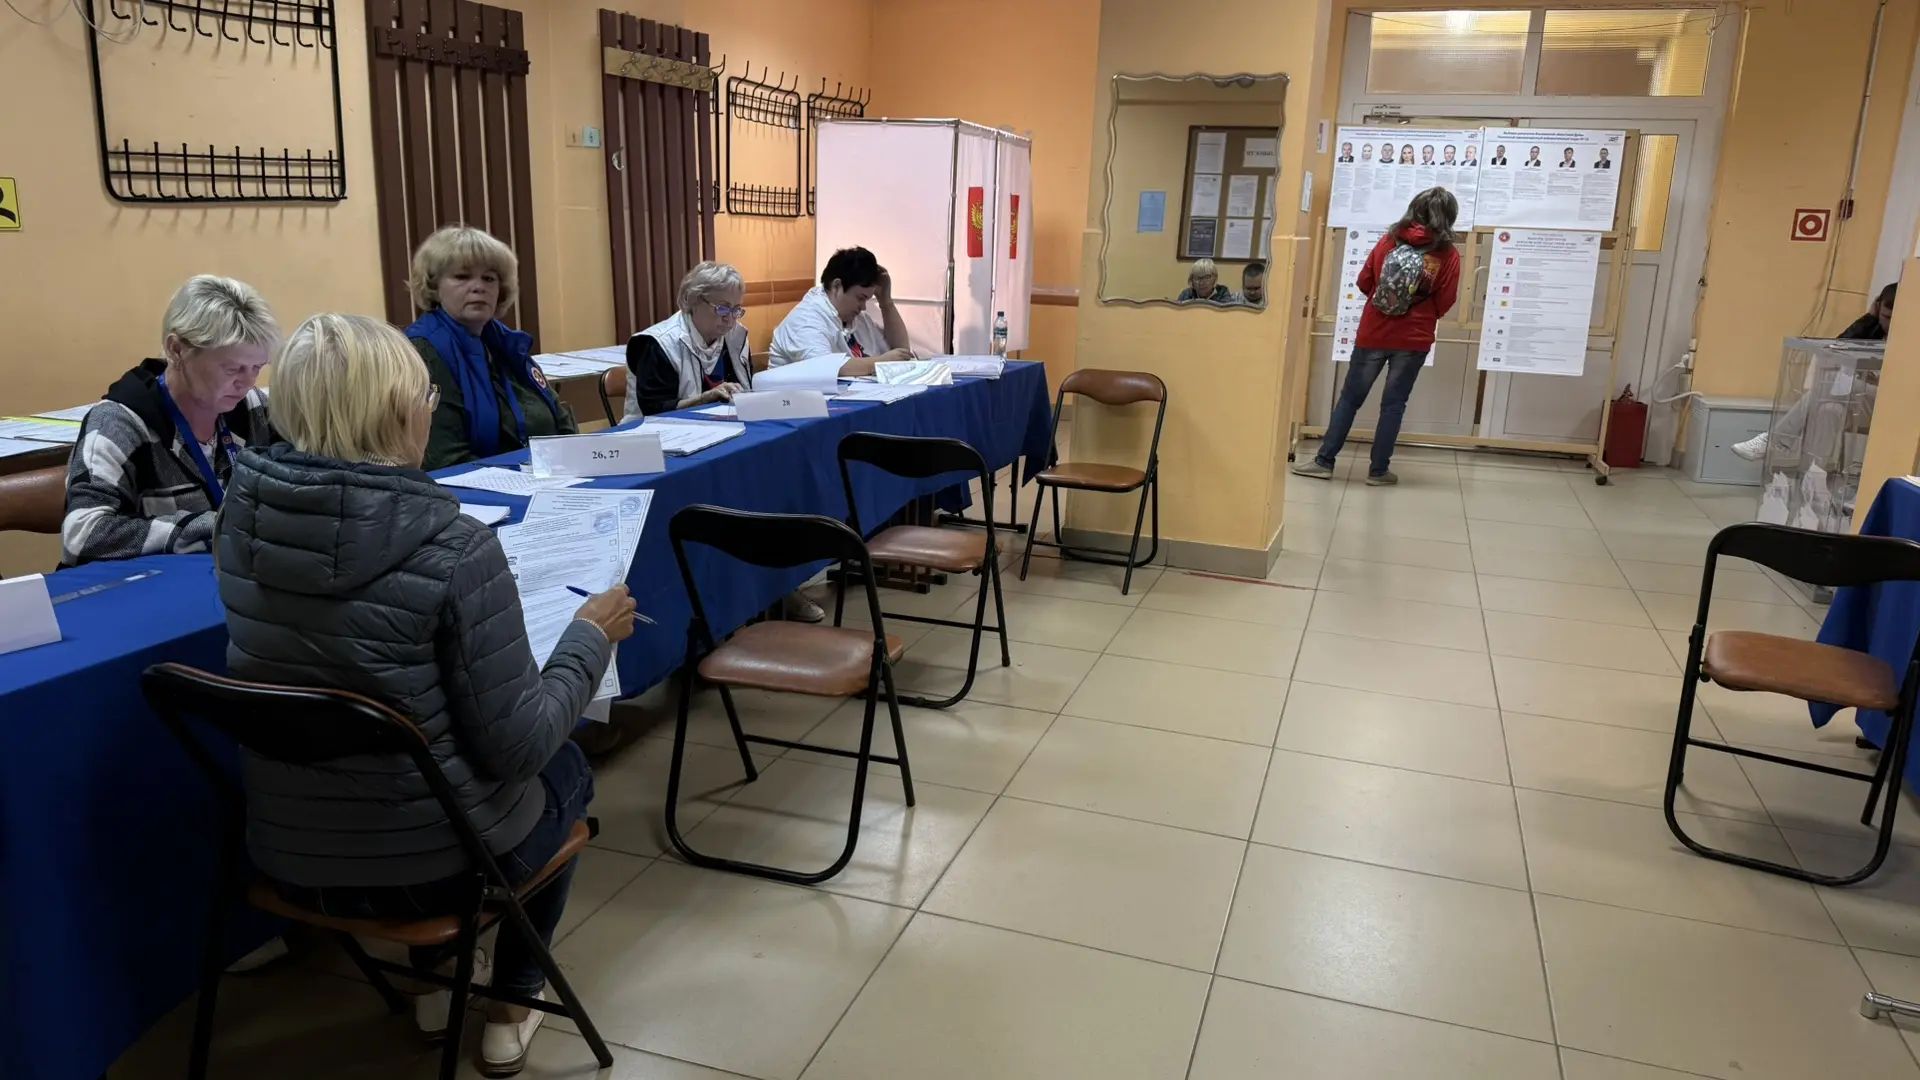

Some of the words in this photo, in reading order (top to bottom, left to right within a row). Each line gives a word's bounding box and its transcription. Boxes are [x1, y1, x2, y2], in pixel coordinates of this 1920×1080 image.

[782, 399, 791, 407] 28
[592, 450, 607, 460] 26,
[609, 449, 620, 459] 27
